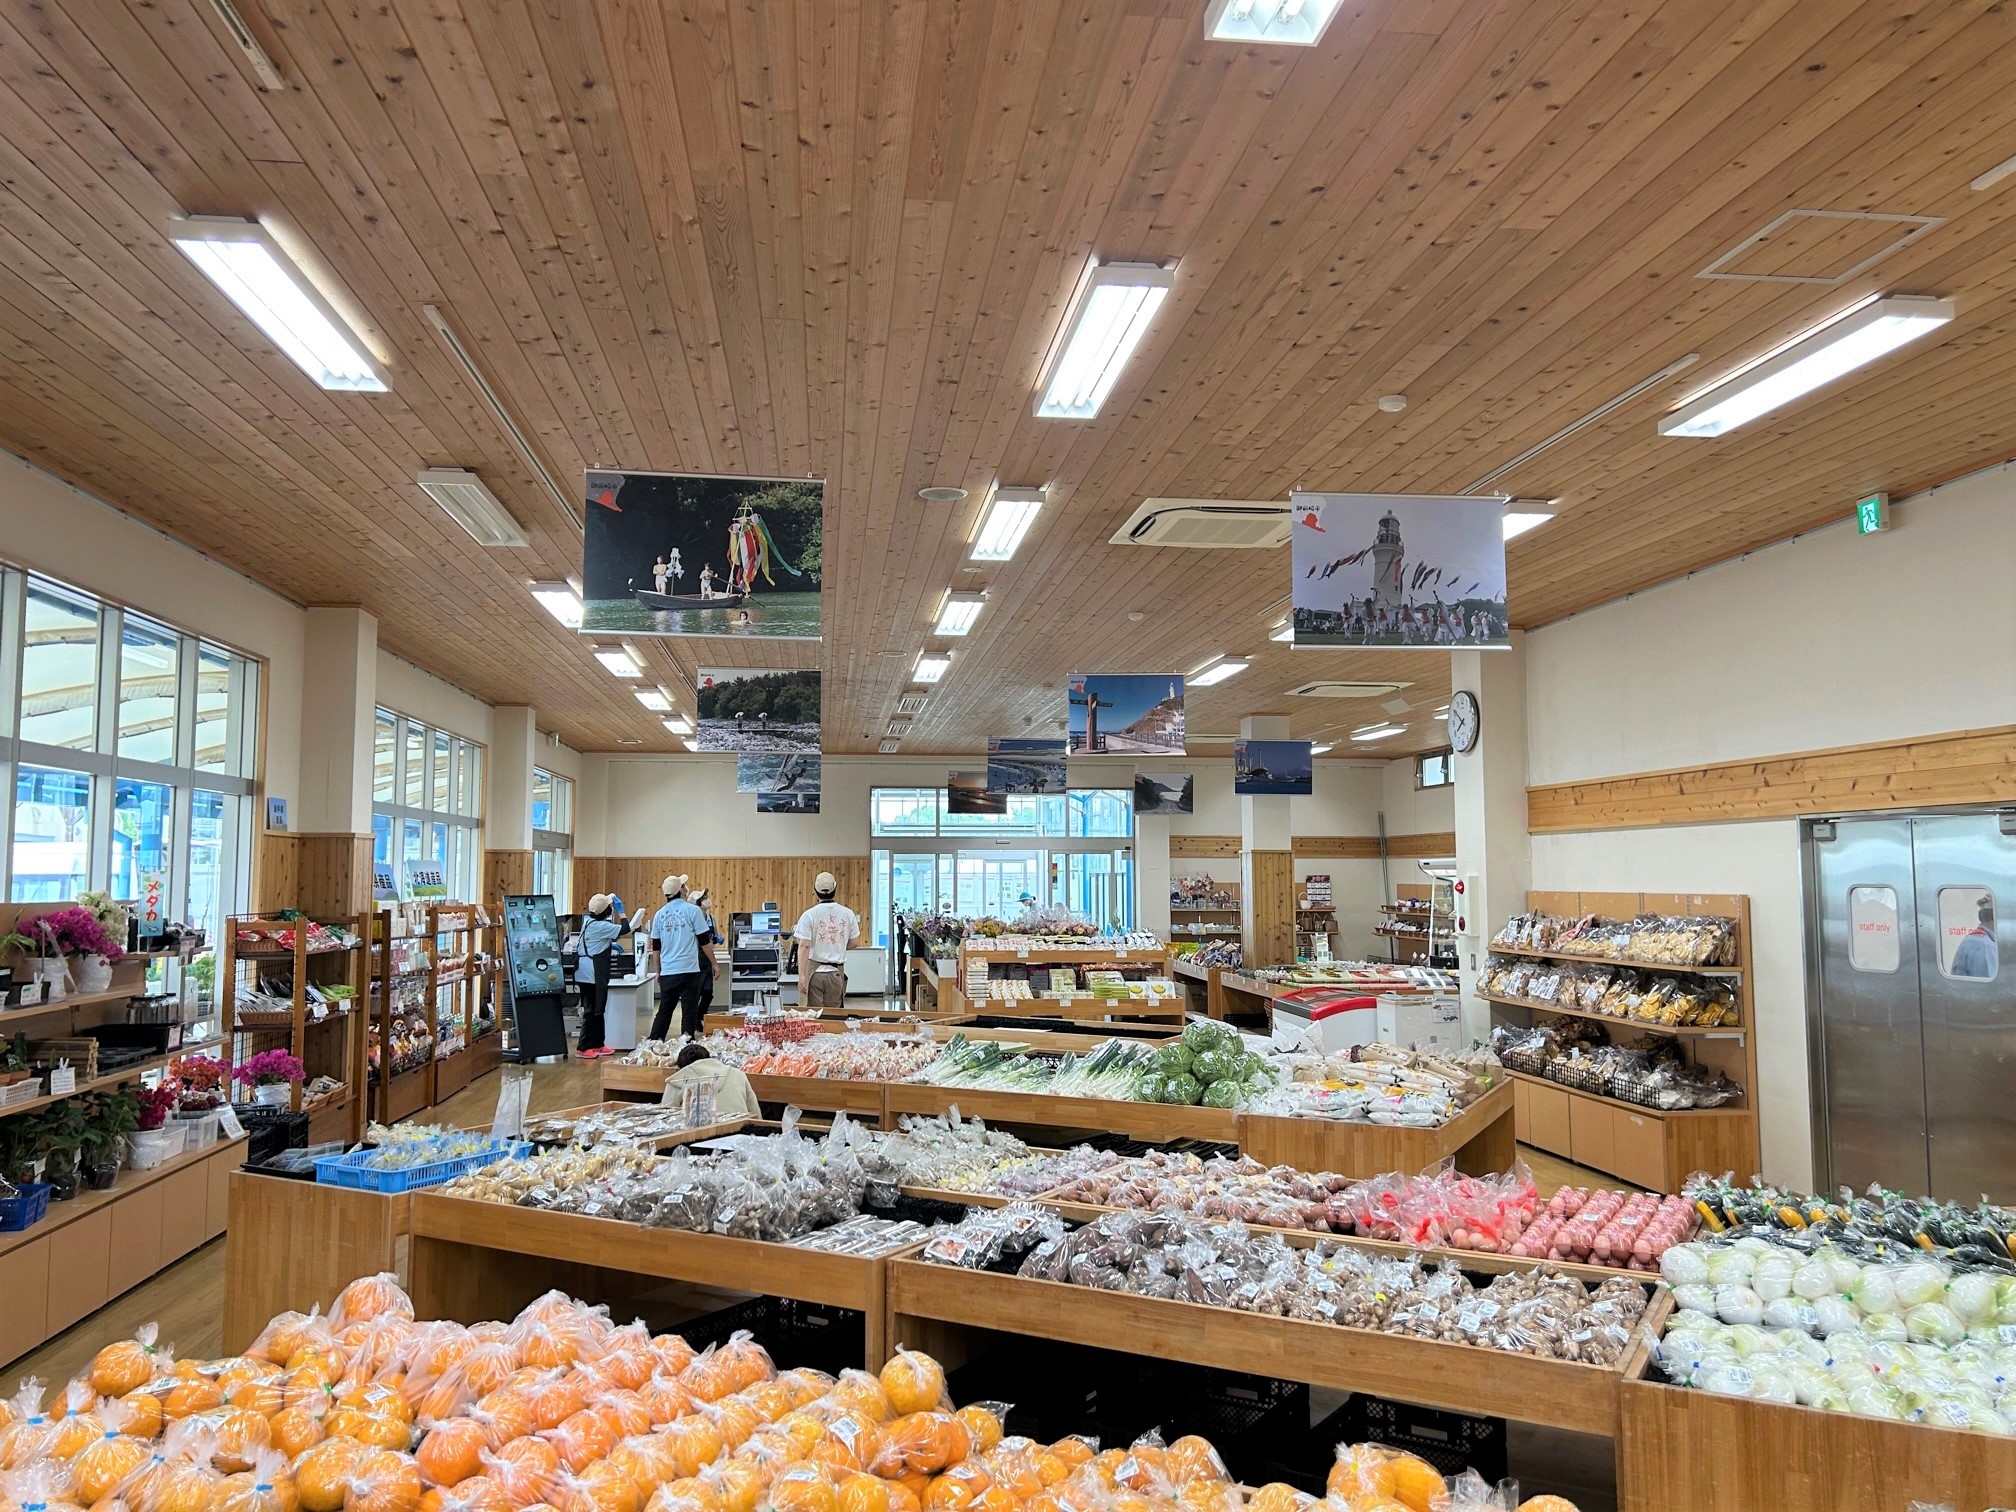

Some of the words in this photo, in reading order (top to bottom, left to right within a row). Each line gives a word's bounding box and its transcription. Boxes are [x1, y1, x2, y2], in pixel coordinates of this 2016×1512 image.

[413, 871, 442, 885] 北海道産品
[146, 880, 160, 921] メダカ
[1859, 923, 1875, 931] staff
[1876, 923, 1891, 933] only
[1949, 927, 1967, 935] staff
